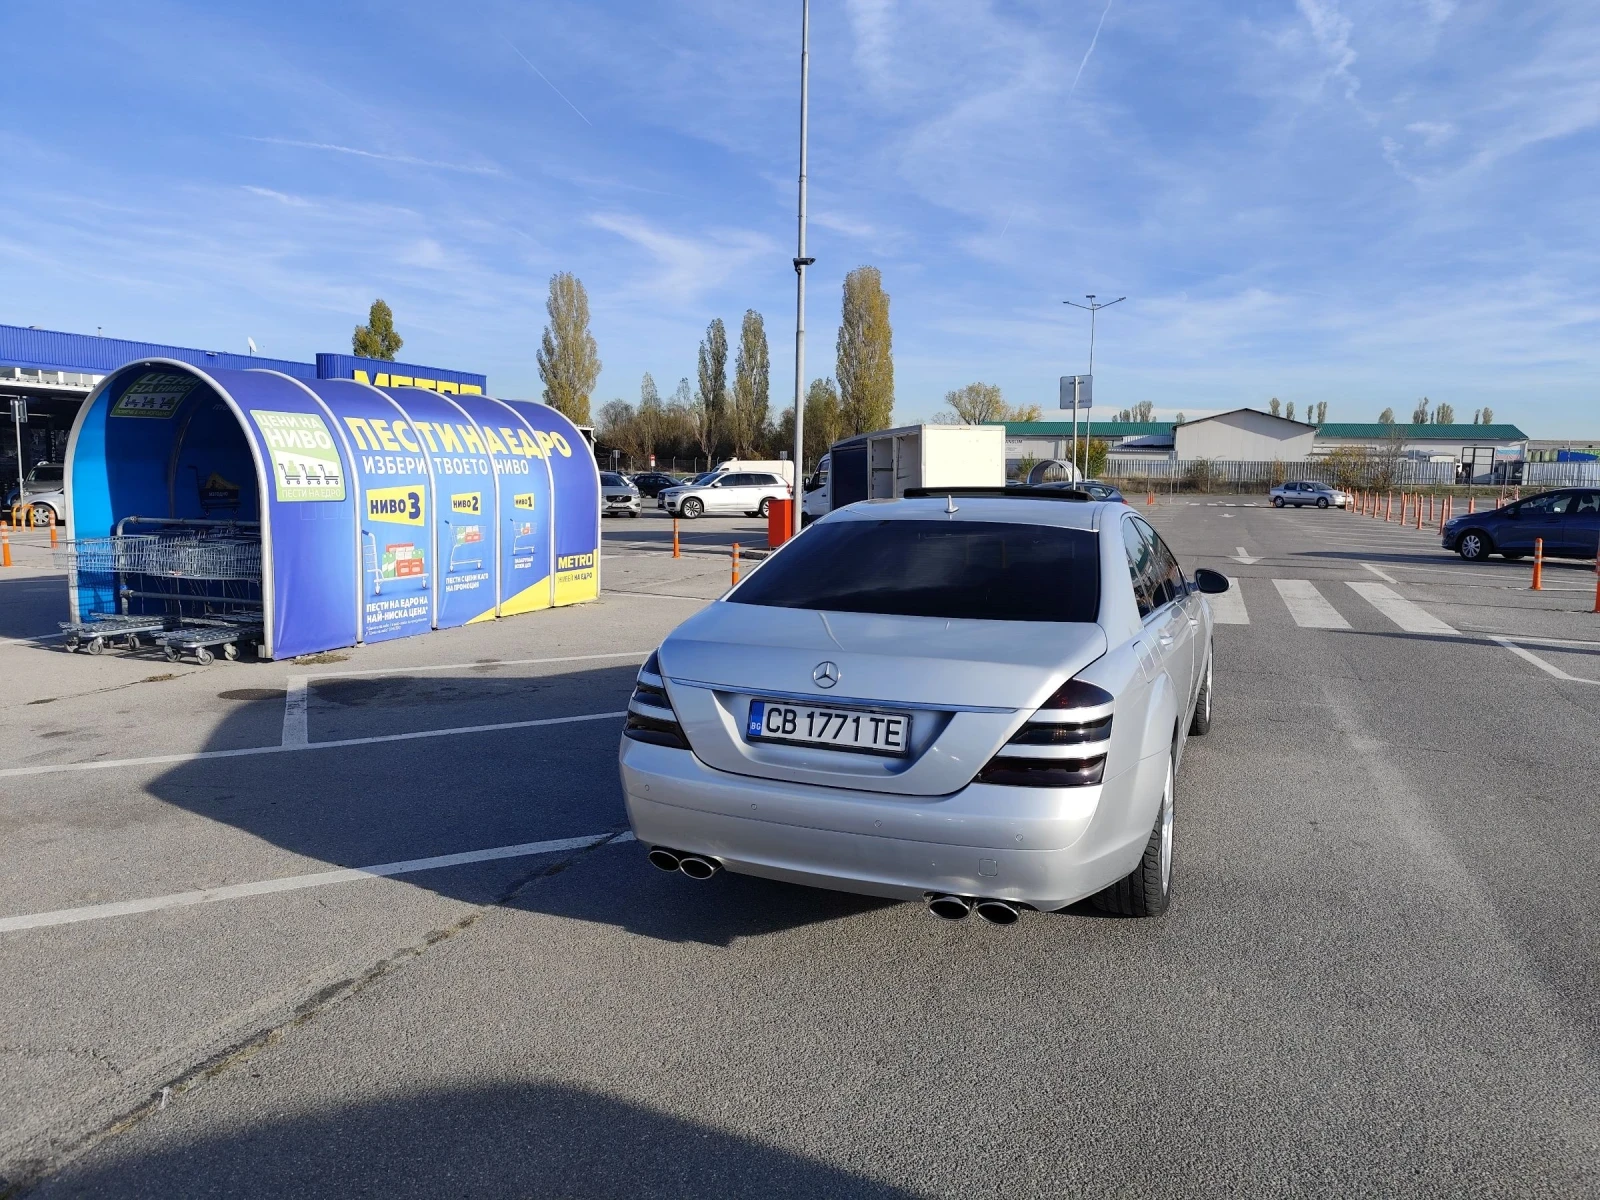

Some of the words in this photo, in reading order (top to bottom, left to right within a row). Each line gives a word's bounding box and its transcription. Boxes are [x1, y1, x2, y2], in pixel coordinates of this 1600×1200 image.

[130, 384, 153, 393] НА
[256, 414, 298, 428] ЦЕНИ
[299, 416, 322, 429] НА
[265, 428, 332, 450] НИВО
[343, 416, 465, 453] ПЕСТИ
[456, 424, 509, 455] НА
[498, 427, 572, 460] ЕДРО
[362, 455, 428, 475] ИЗБЕРИ
[433, 457, 488, 475] ТВОЕТО
[494, 458, 529, 475] НИВО
[282, 489, 307, 499] ПЕСТИ
[308, 489, 320, 498] НА
[321, 489, 341, 499] ЕДРО
[528, 496, 533, 507] 1
[370, 499, 406, 514] НИВО
[408, 491, 421, 520] 3
[453, 500, 471, 509] НИВО
[472, 495, 479, 511] 2
[558, 553, 593, 570] METRO
[366, 601, 389, 613] ПЕСТИ
[390, 600, 400, 609] НА
[401, 597, 419, 608] ЕДРО
[420, 596, 428, 604] НА
[366, 609, 408, 624] НАЙ-НИСКА
[750, 721, 762, 730] BG
[766, 707, 797, 735] CB
[806, 711, 861, 742] 1771
[869, 717, 902, 747] TE
